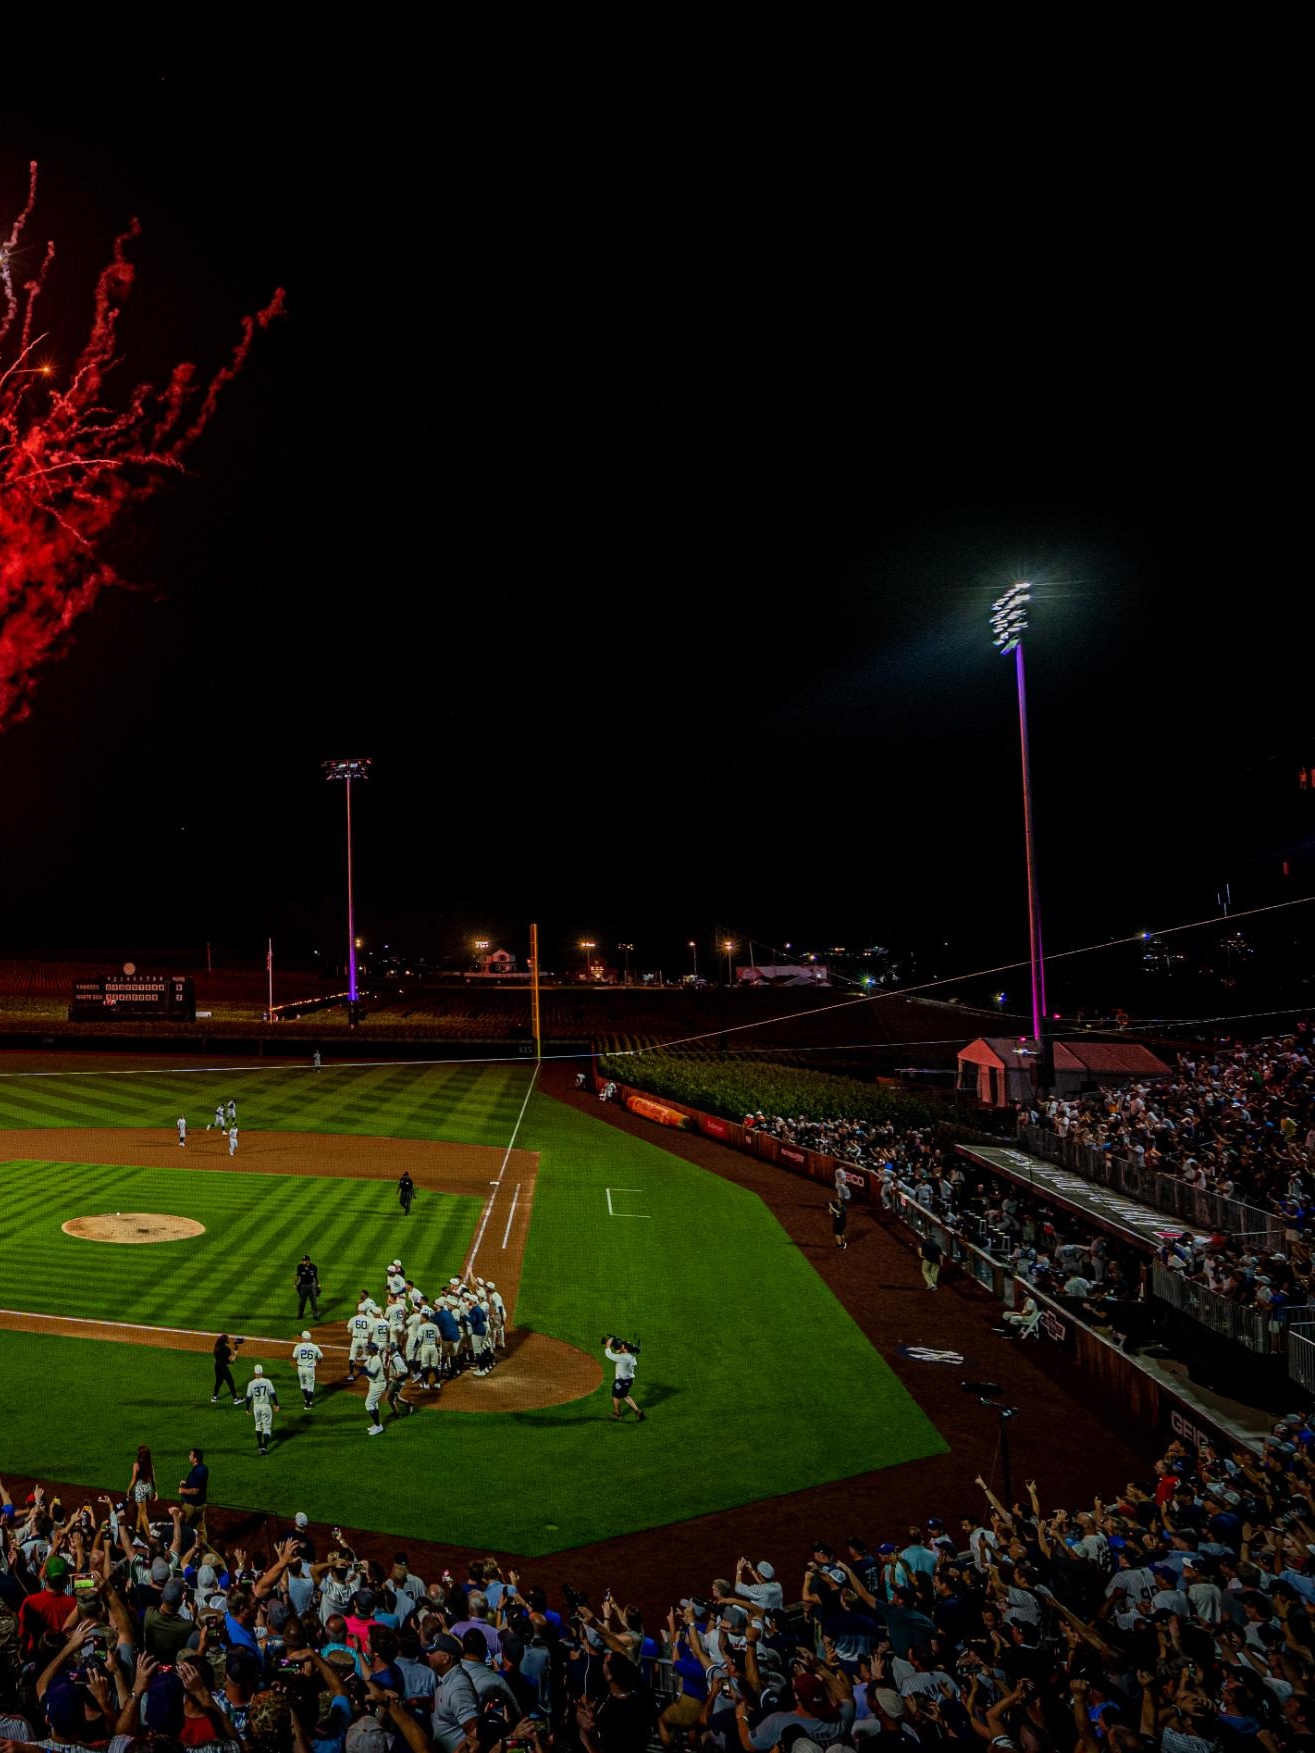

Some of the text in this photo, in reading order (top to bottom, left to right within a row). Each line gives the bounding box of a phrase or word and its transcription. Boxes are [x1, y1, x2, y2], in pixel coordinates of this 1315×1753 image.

[846, 1171, 865, 1188] EICO
[355, 1320, 368, 1330] 60
[377, 1324, 388, 1335] 23
[425, 1329, 435, 1338] 12
[300, 1349, 313, 1360] 26
[252, 1386, 267, 1398] 37
[1170, 1410, 1209, 1448] GEIC
